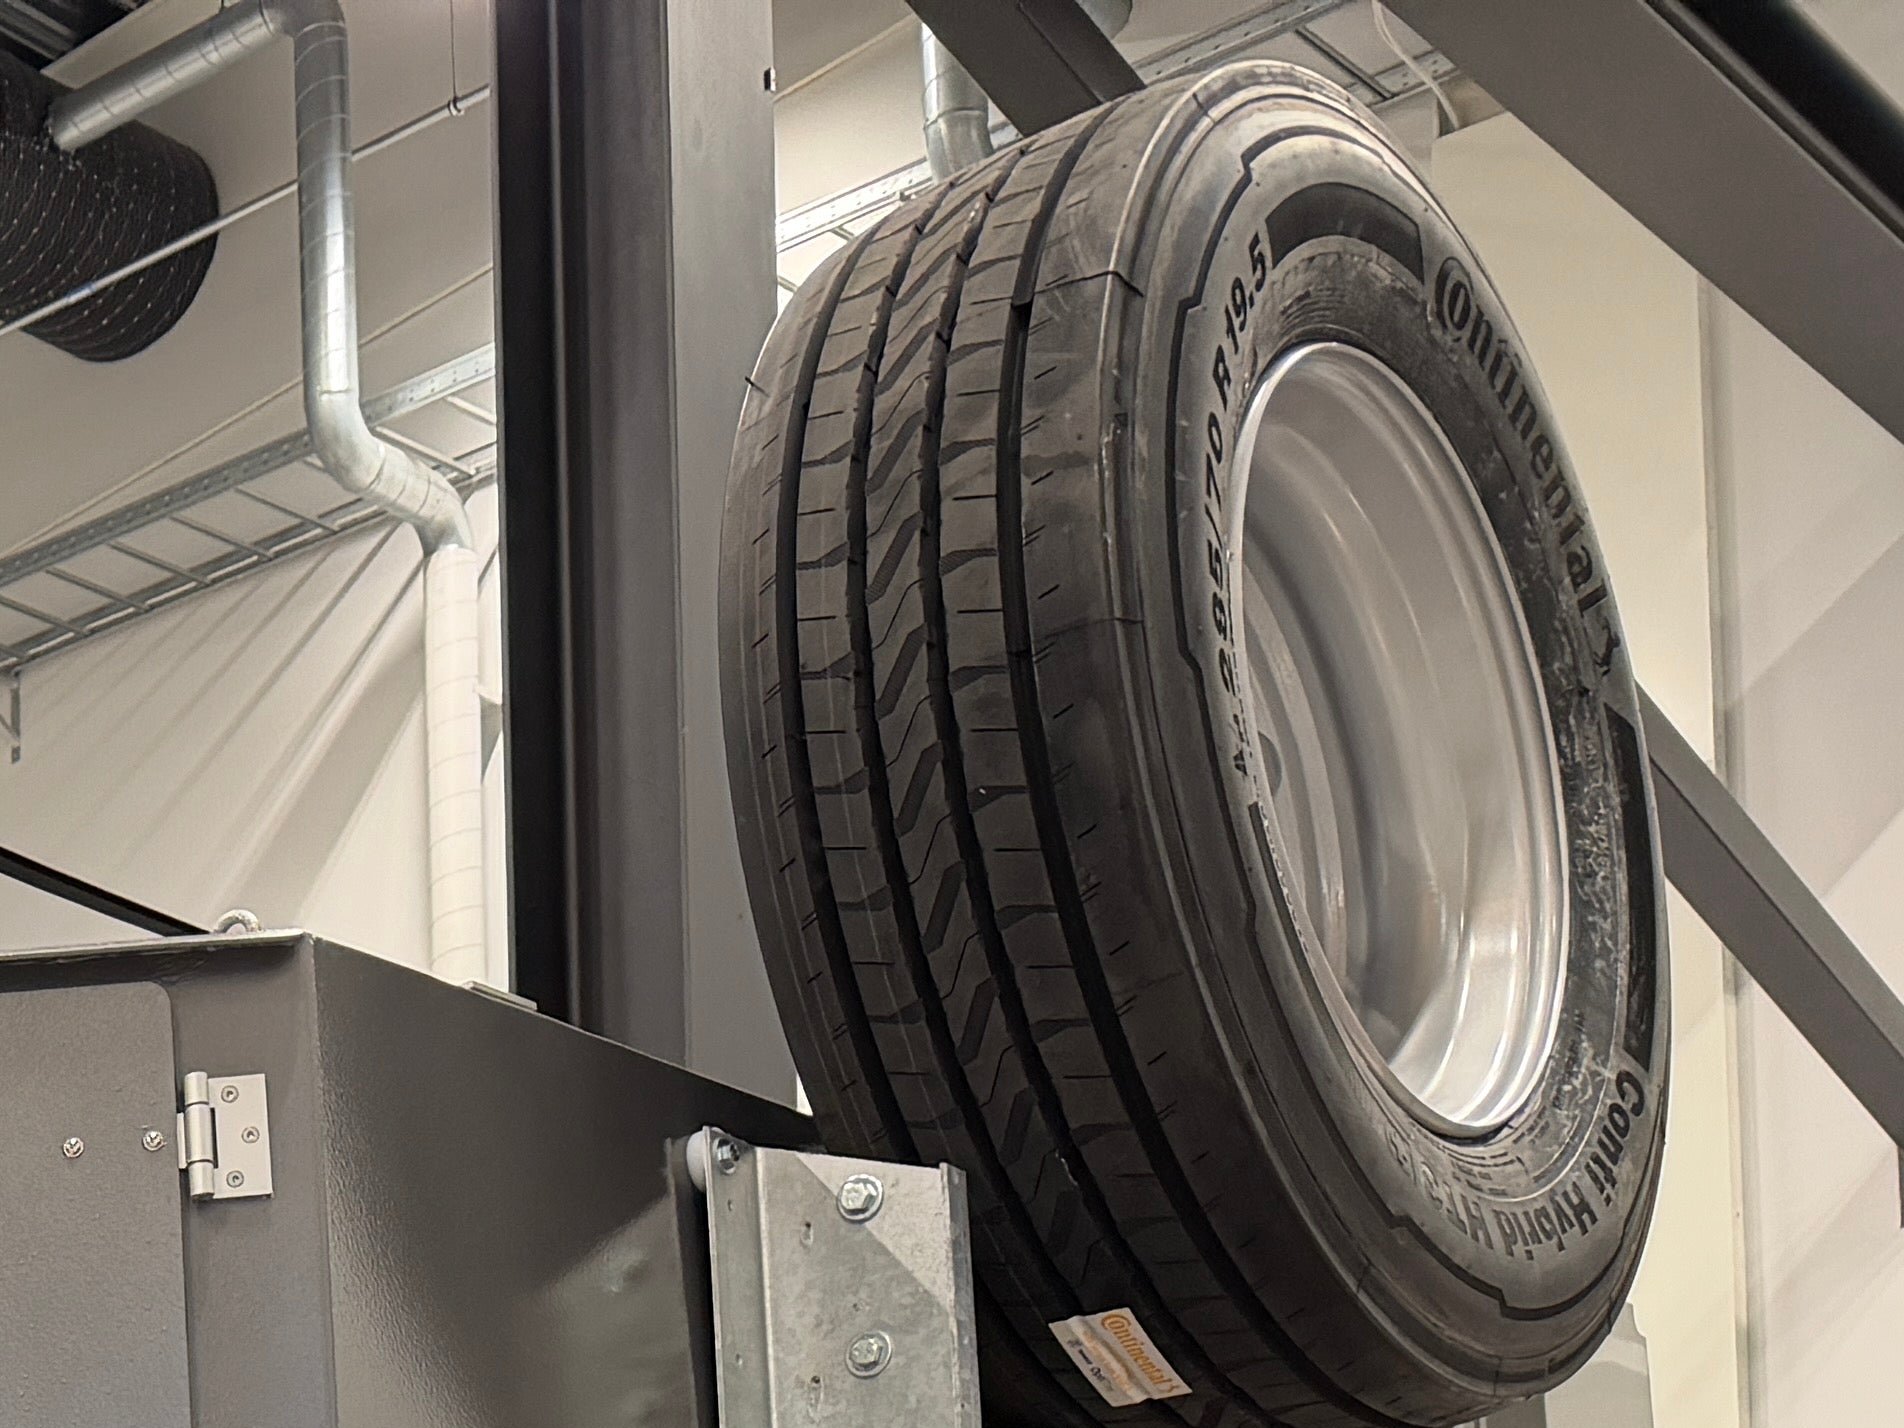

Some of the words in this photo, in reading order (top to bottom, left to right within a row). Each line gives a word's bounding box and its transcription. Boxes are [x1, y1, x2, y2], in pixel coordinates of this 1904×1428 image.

[1223, 230, 1267, 357] 19.5
[1211, 342, 1233, 413] R
[1433, 255, 1612, 618] Continental
[1204, 410, 1237, 698] 285/70
[1582, 1069, 1647, 1208] Conti
[1492, 1180, 1599, 1262] Hybrid
[1100, 1313, 1174, 1388] Continental
